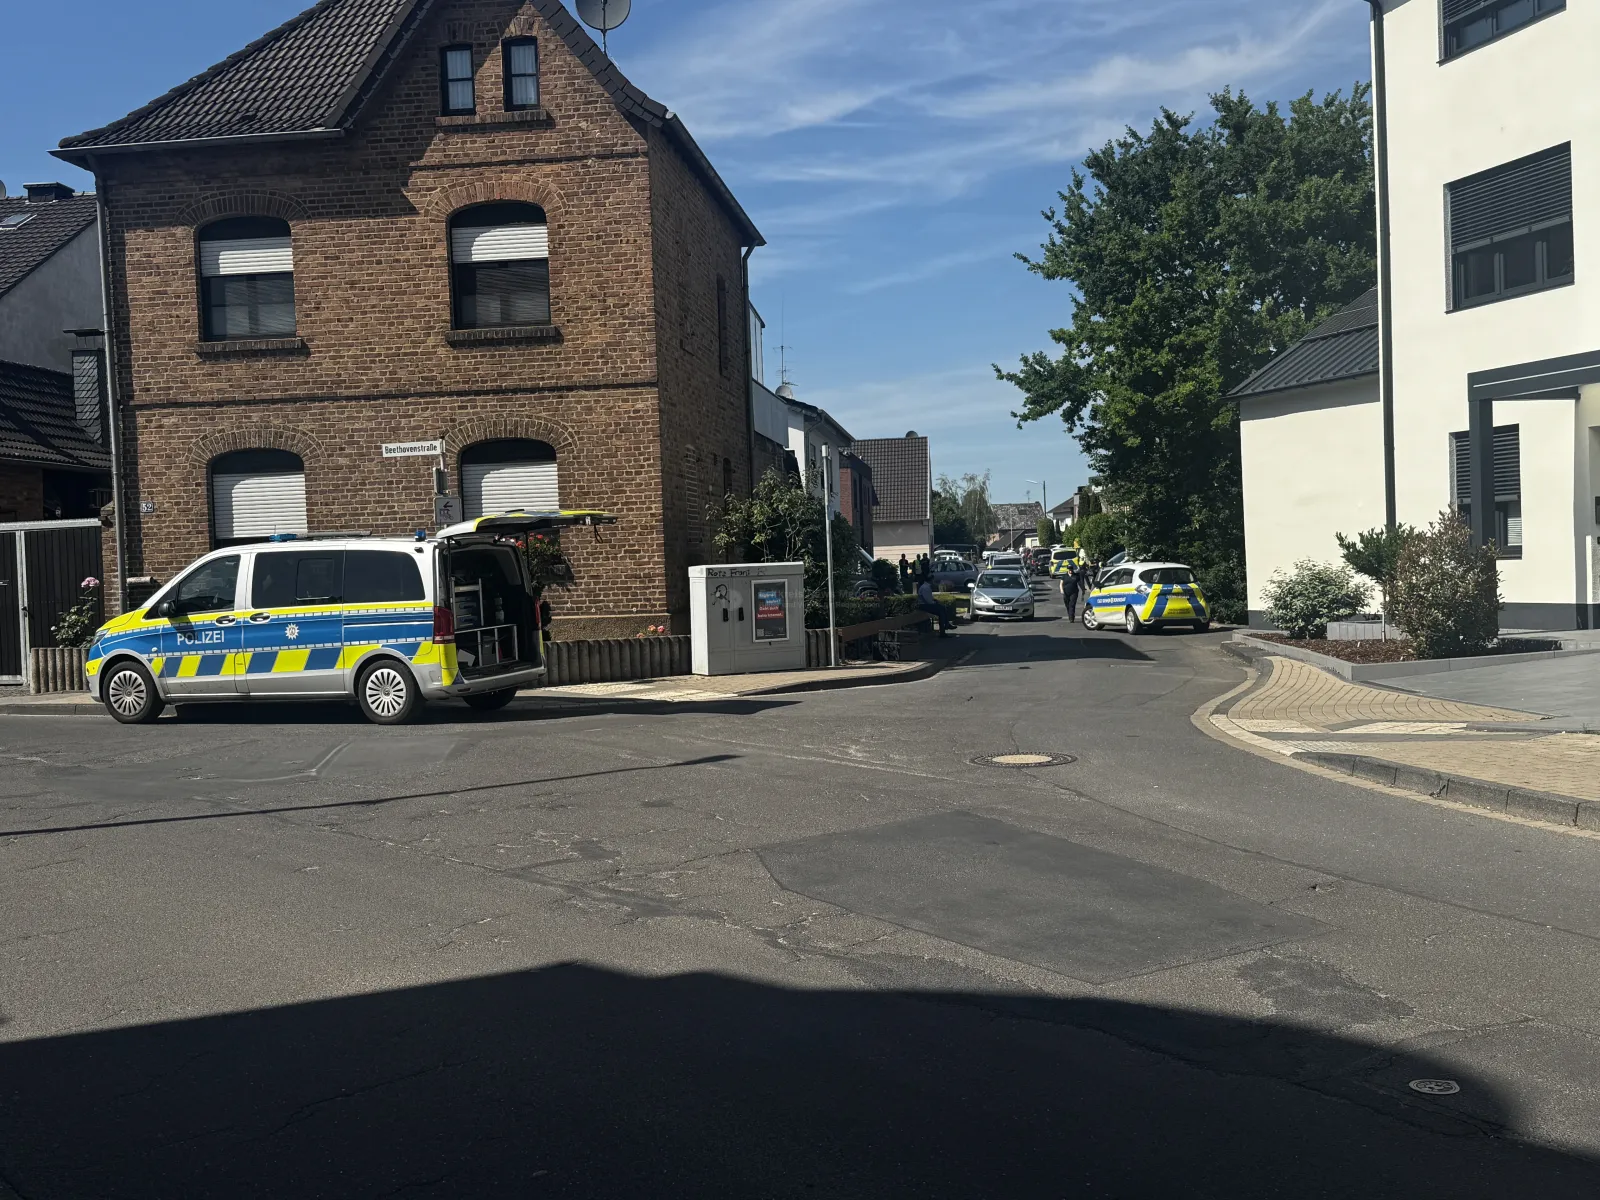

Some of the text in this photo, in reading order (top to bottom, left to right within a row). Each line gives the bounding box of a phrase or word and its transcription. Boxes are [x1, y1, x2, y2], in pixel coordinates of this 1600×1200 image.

[384, 443, 438, 454] Beethovenstraße
[142, 503, 152, 511] 52
[176, 630, 225, 646] POLIZEI
